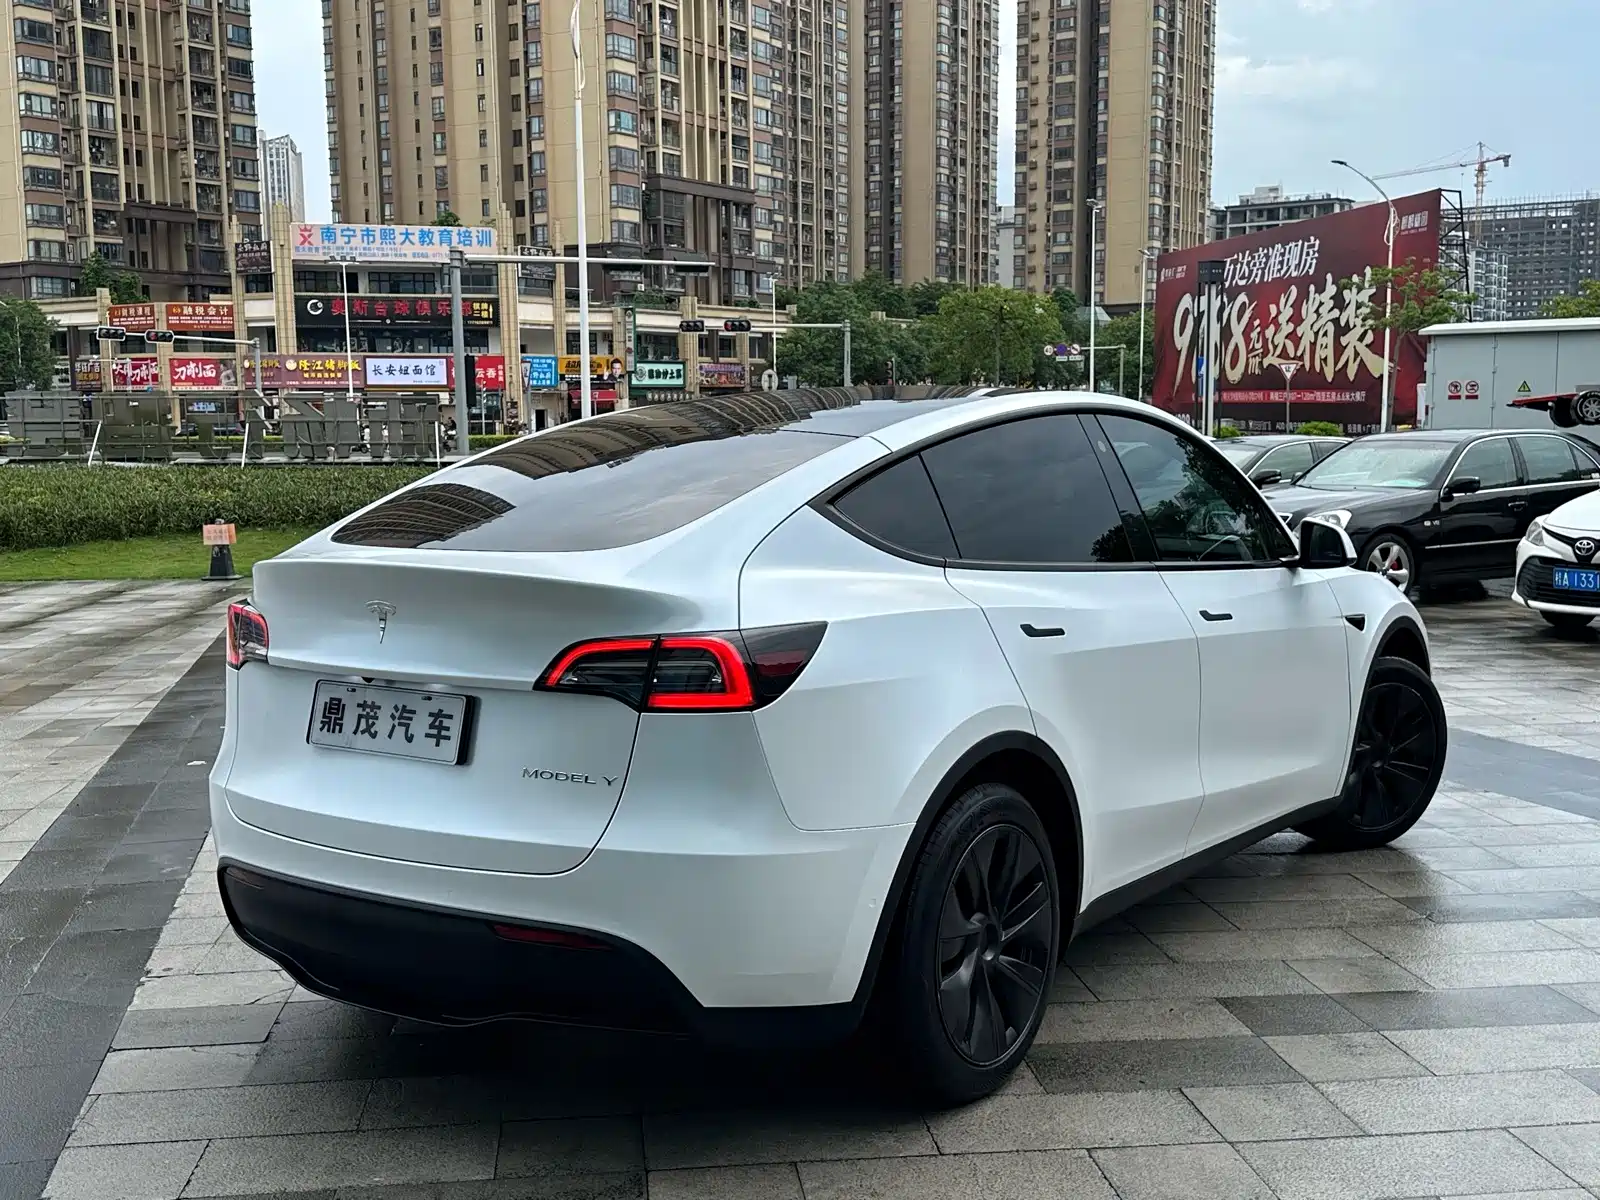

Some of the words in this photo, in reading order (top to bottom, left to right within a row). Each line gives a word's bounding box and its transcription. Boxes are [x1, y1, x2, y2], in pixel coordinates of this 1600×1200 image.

[320, 226, 493, 248] 南宁市熙大教育培训
[1223, 236, 1320, 289] 万达旁准现房
[331, 300, 473, 316] 奥斯台球俱乐部
[1263, 267, 1396, 382] 送精装
[173, 361, 217, 380] 刀削面
[372, 364, 437, 376] 长安妞面馆
[319, 697, 453, 747] 鼎茂汽车
[522, 767, 596, 784] MODEL
[602, 775, 618, 787] Y
